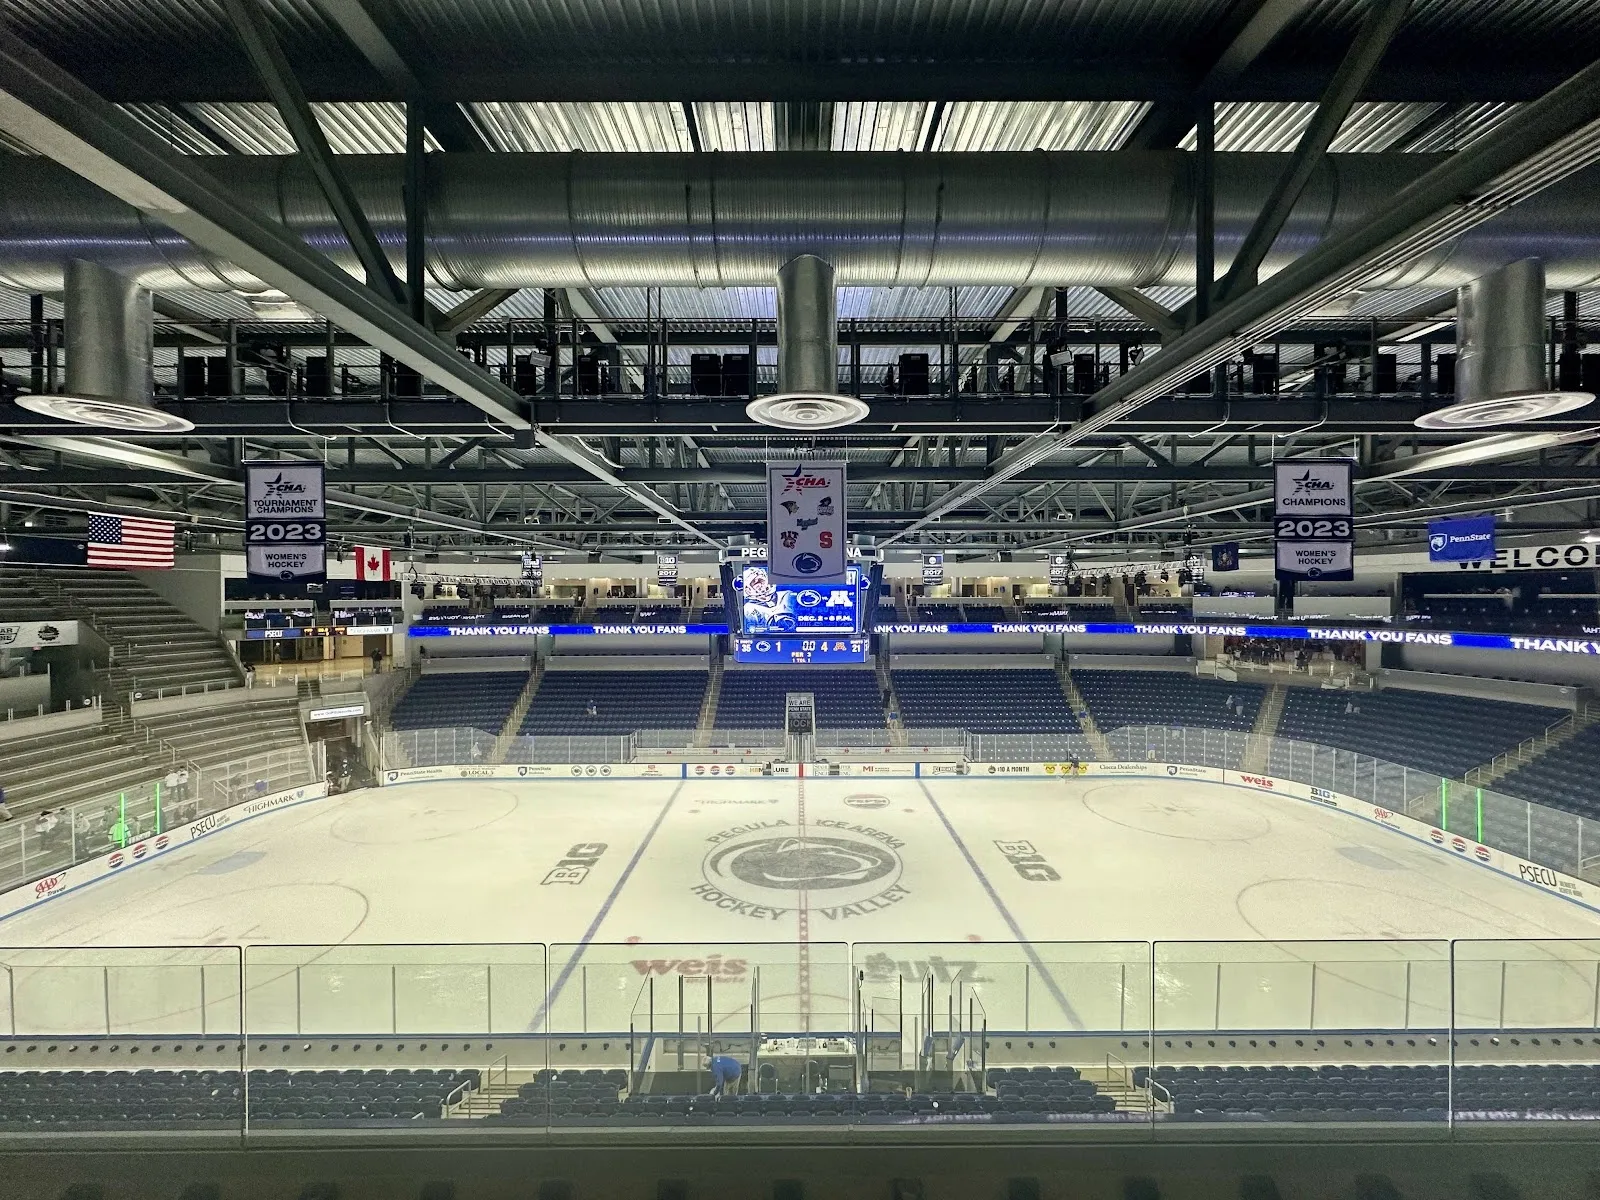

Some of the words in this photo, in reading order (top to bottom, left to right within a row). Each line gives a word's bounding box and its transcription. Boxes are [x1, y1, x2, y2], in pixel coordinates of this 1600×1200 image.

[796, 477, 826, 486] CHA
[253, 499, 318, 507] TOURNAMENT
[1282, 498, 1346, 506] CHAMPIONS
[250, 523, 322, 540] 2023
[1278, 520, 1350, 537] 2023
[448, 626, 492, 636] THANK
[492, 626, 518, 635] YOU
[518, 626, 550, 635] FANS
[593, 626, 632, 634] THANK
[630, 626, 656, 634] YOU
[656, 626, 686, 634] FANS
[892, 625, 918, 633] YOU
[918, 625, 948, 633] FANS
[992, 624, 1030, 632] THANK
[1032, 624, 1055, 632] YOU
[1056, 624, 1086, 632] FANS
[1134, 625, 1178, 634] THANK
[1178, 626, 1206, 635] YOU
[1208, 626, 1246, 636] FANS
[1307, 629, 1368, 640] THANK
[1366, 630, 1400, 642] YOU
[1406, 632, 1453, 645] FANS
[776, 642, 780, 652] 1
[820, 642, 828, 652] 4
[1510, 638, 1590, 654] THANK
[1240, 775, 1274, 788] weis
[248, 794, 294, 814] HIGHMARK
[190, 816, 216, 840] PSECU
[706, 818, 790, 844] PEGULA
[816, 818, 850, 830] ICE
[848, 824, 906, 849] ARENA
[1519, 864, 1557, 886] PSECU
[37, 878, 58, 893] AAA
[48, 885, 66, 897] Travel
[690, 883, 788, 921] HOCKEY
[818, 884, 912, 921] VALLEY
[630, 954, 748, 976] weis
